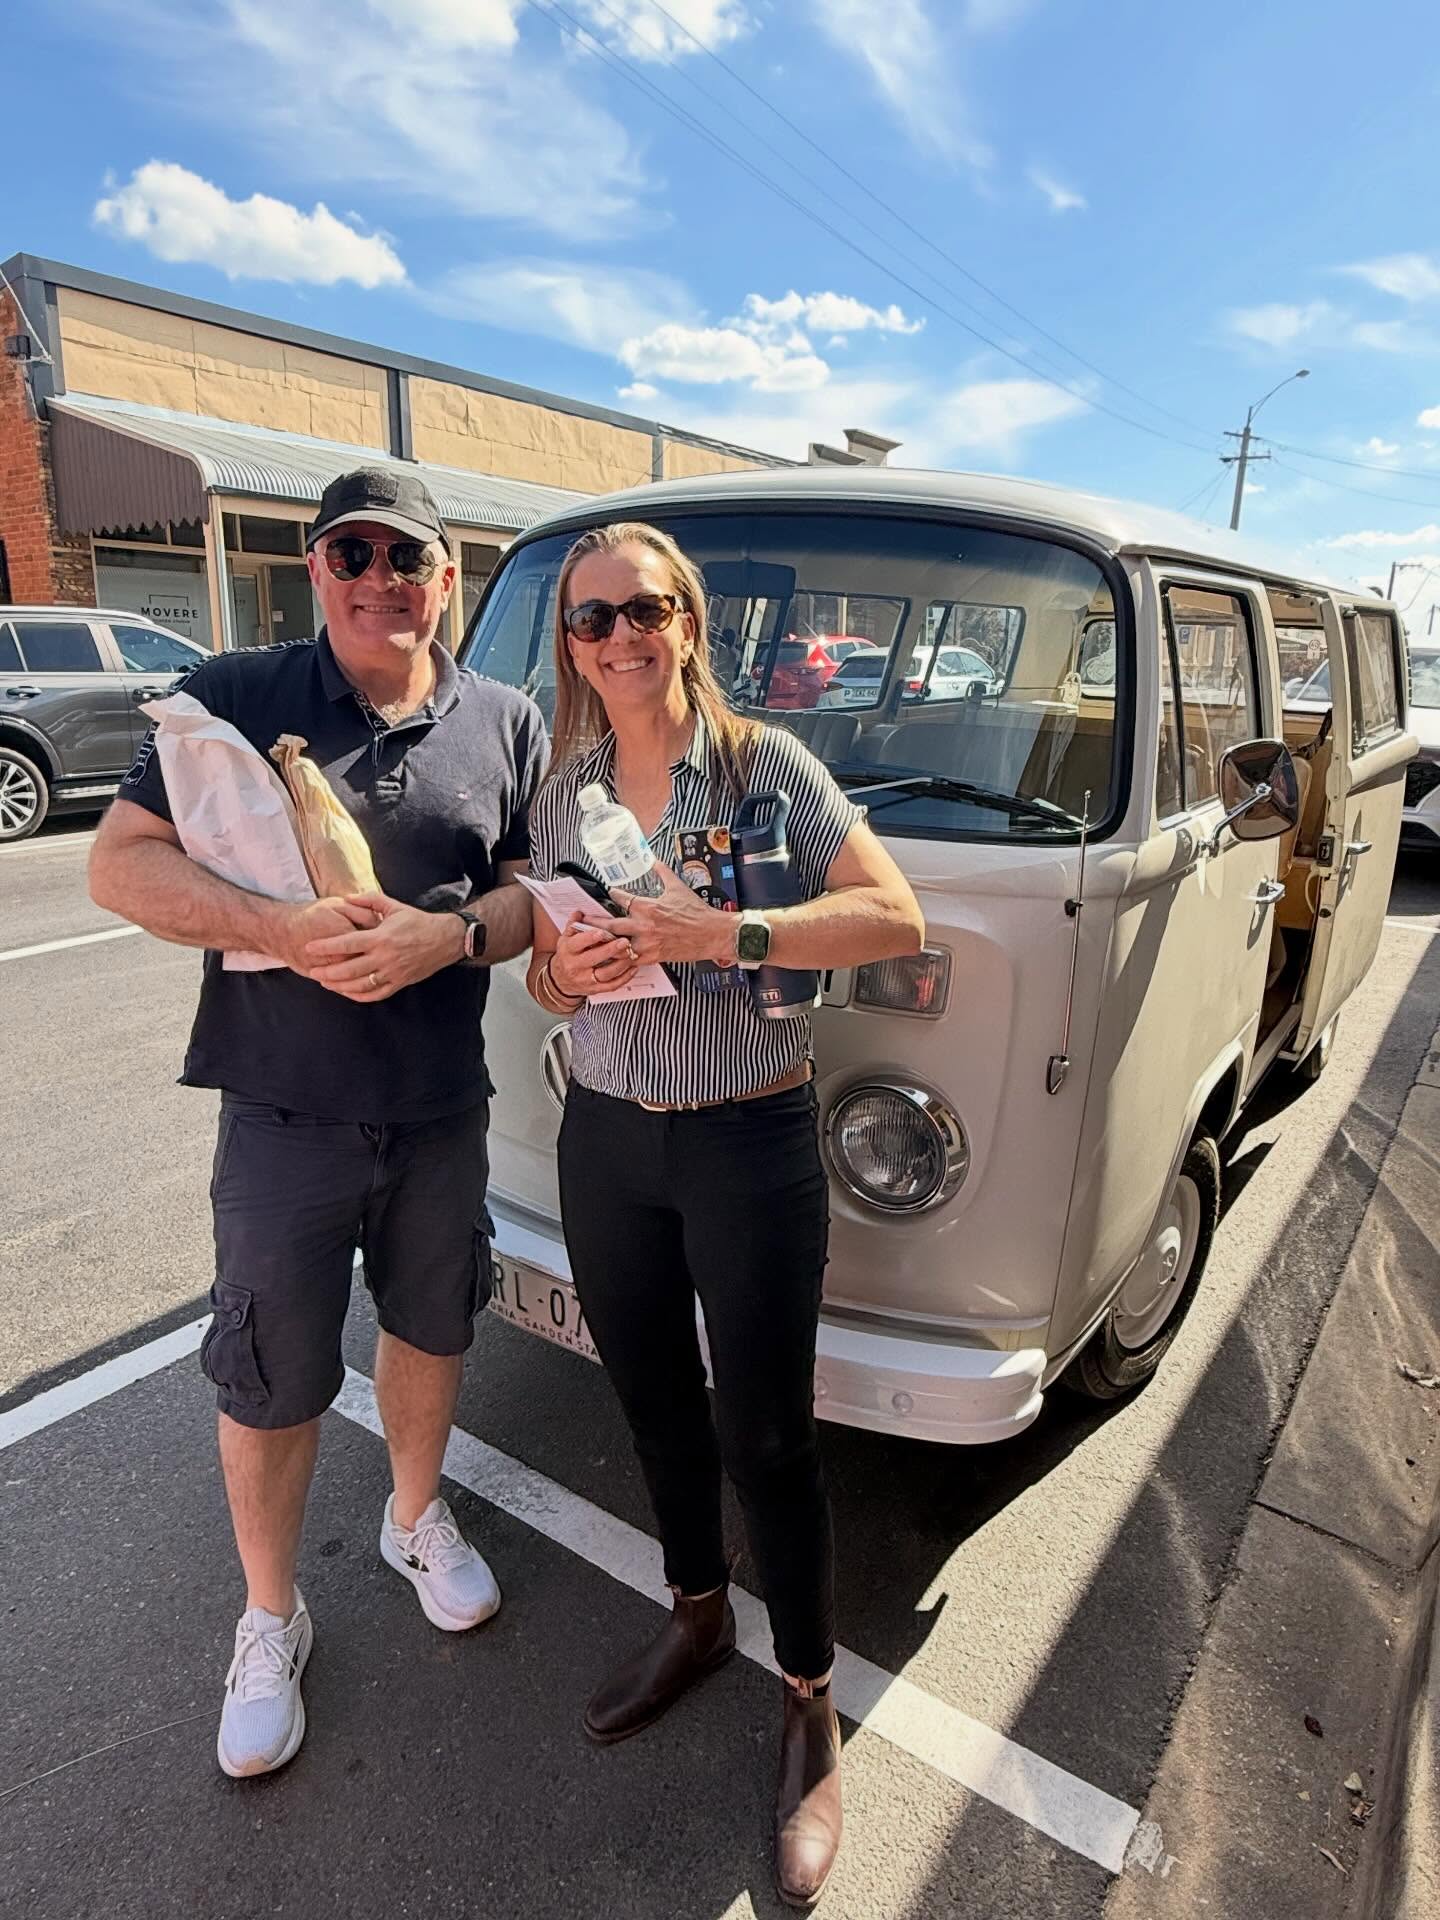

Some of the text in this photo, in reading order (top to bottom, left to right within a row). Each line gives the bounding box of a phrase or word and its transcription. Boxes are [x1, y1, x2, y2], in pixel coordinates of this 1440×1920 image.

[140, 607, 199, 619] MOVERE
[492, 1260, 584, 1338] RL-07
[490, 1300, 516, 1320] ORIA
[576, 1340, 598, 1357] STA
